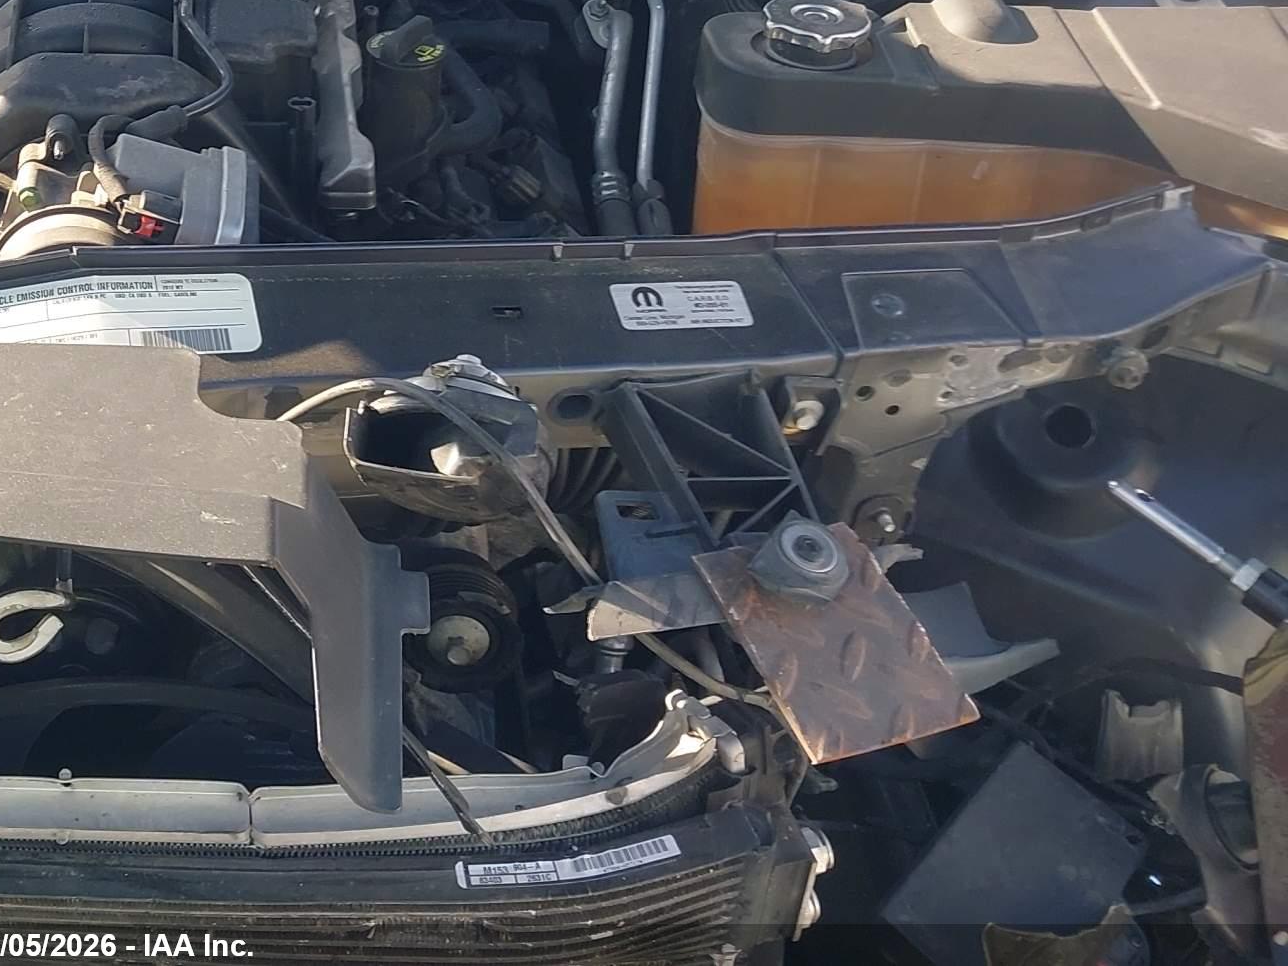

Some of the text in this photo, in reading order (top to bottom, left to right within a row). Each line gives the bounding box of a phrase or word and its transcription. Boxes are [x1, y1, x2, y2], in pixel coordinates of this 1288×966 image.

[16, 287, 54, 302] EMISSION
[57, 282, 94, 296] CONTROL
[97, 281, 153, 292] INFORMATION
